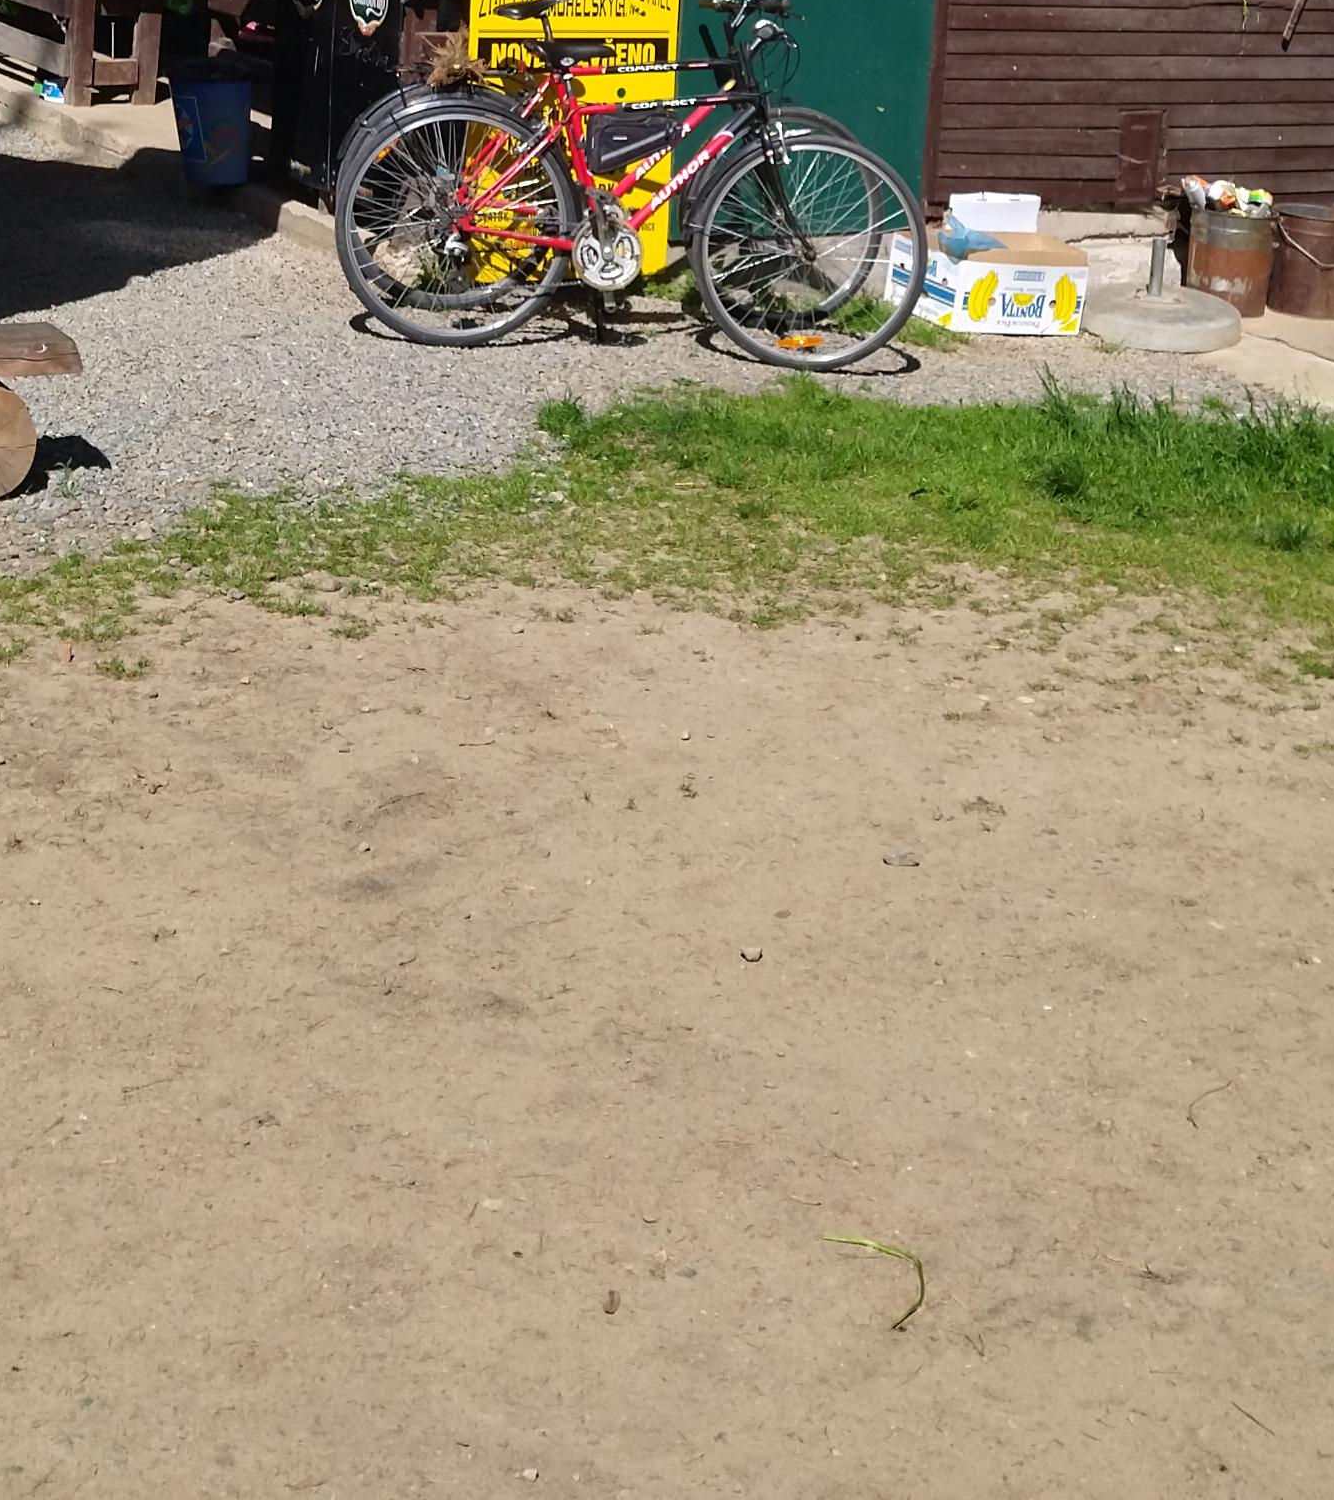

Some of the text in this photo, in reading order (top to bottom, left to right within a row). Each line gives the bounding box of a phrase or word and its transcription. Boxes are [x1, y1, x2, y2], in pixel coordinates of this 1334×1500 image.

[617, 63, 680, 73] COMPACT
[650, 150, 710, 211] AUTHOR
[999, 293, 1047, 319] BONITA
